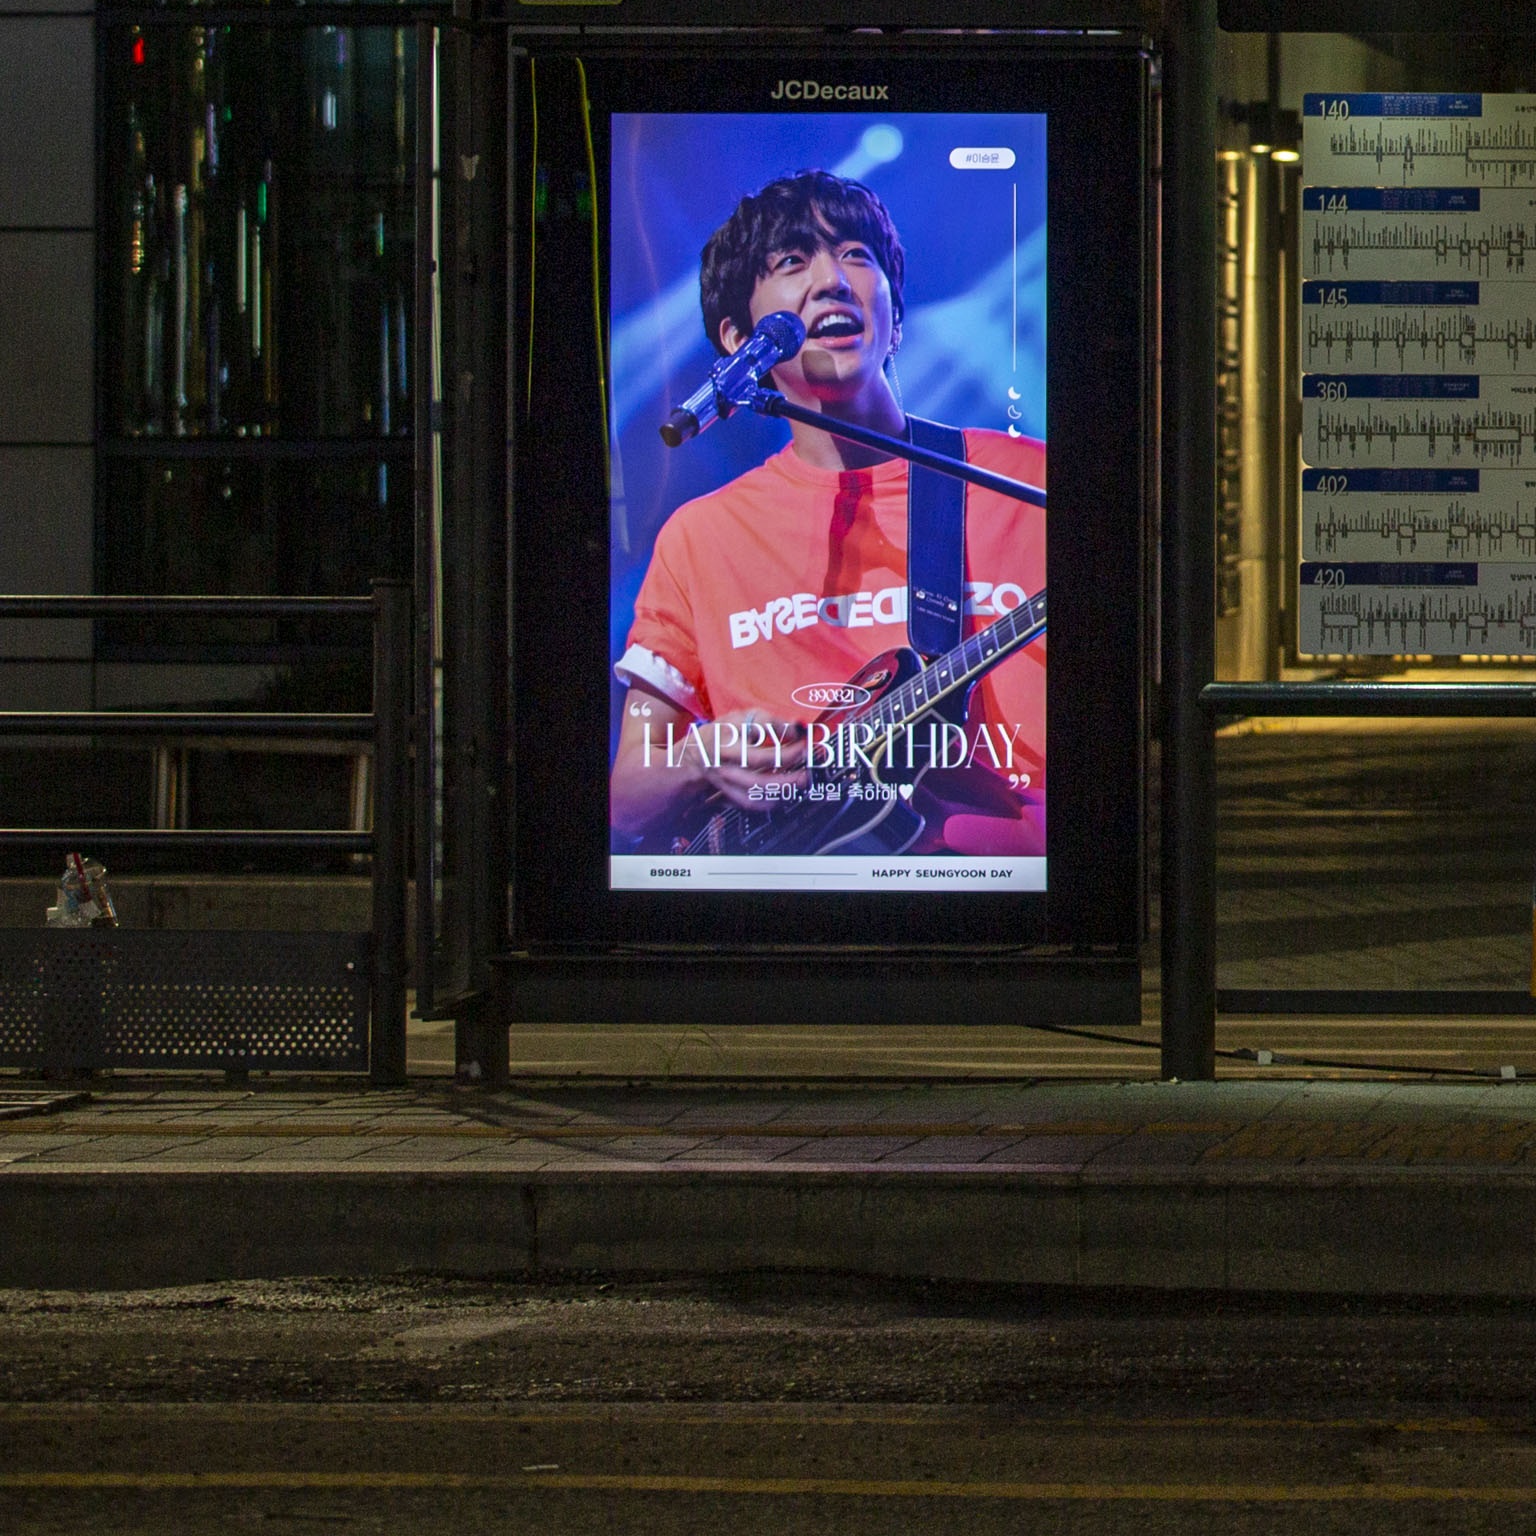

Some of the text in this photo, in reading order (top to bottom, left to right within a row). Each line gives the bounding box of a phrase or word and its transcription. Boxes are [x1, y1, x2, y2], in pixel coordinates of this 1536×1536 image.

[771, 81, 889, 100] JCDecaux
[1319, 100, 1349, 119] 140
[1318, 194, 1348, 214] 144
[1318, 288, 1348, 308] 145
[1316, 381, 1347, 401] 360
[1316, 475, 1347, 495] 402
[1313, 568, 1345, 589] 420
[808, 688, 855, 703] 890821
[643, 723, 1021, 769] HAPPY BIRTHDAY
[747, 784, 802, 800] 승윤아,
[808, 783, 841, 801] 생일
[650, 868, 692, 877] 890821
[872, 868, 1014, 879] HAPPY SEUNGYOON DAY
